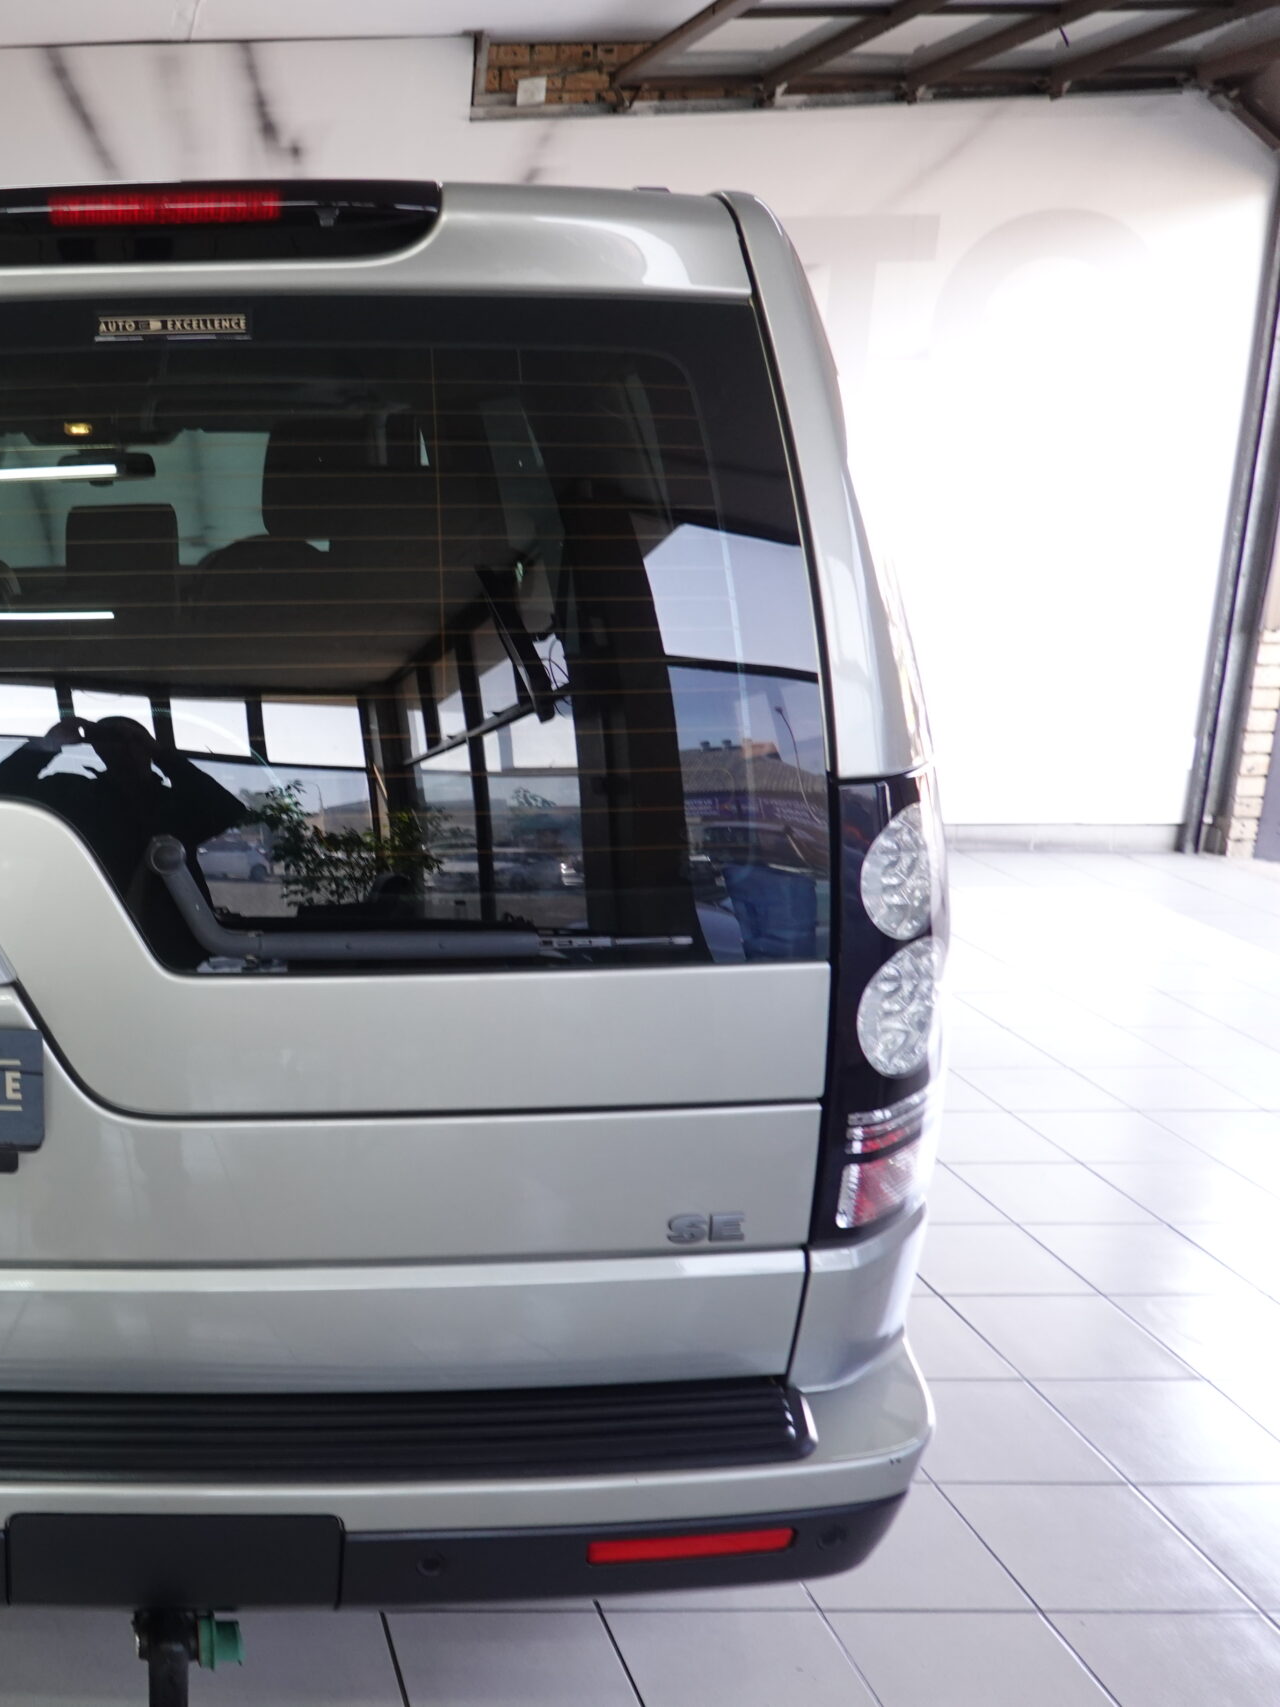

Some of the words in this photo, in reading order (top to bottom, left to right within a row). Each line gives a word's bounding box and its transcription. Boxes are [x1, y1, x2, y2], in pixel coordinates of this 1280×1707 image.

[99, 320, 136, 333] AUTO
[167, 317, 247, 331] EXCELLENCE
[666, 1211, 746, 1244] SE
